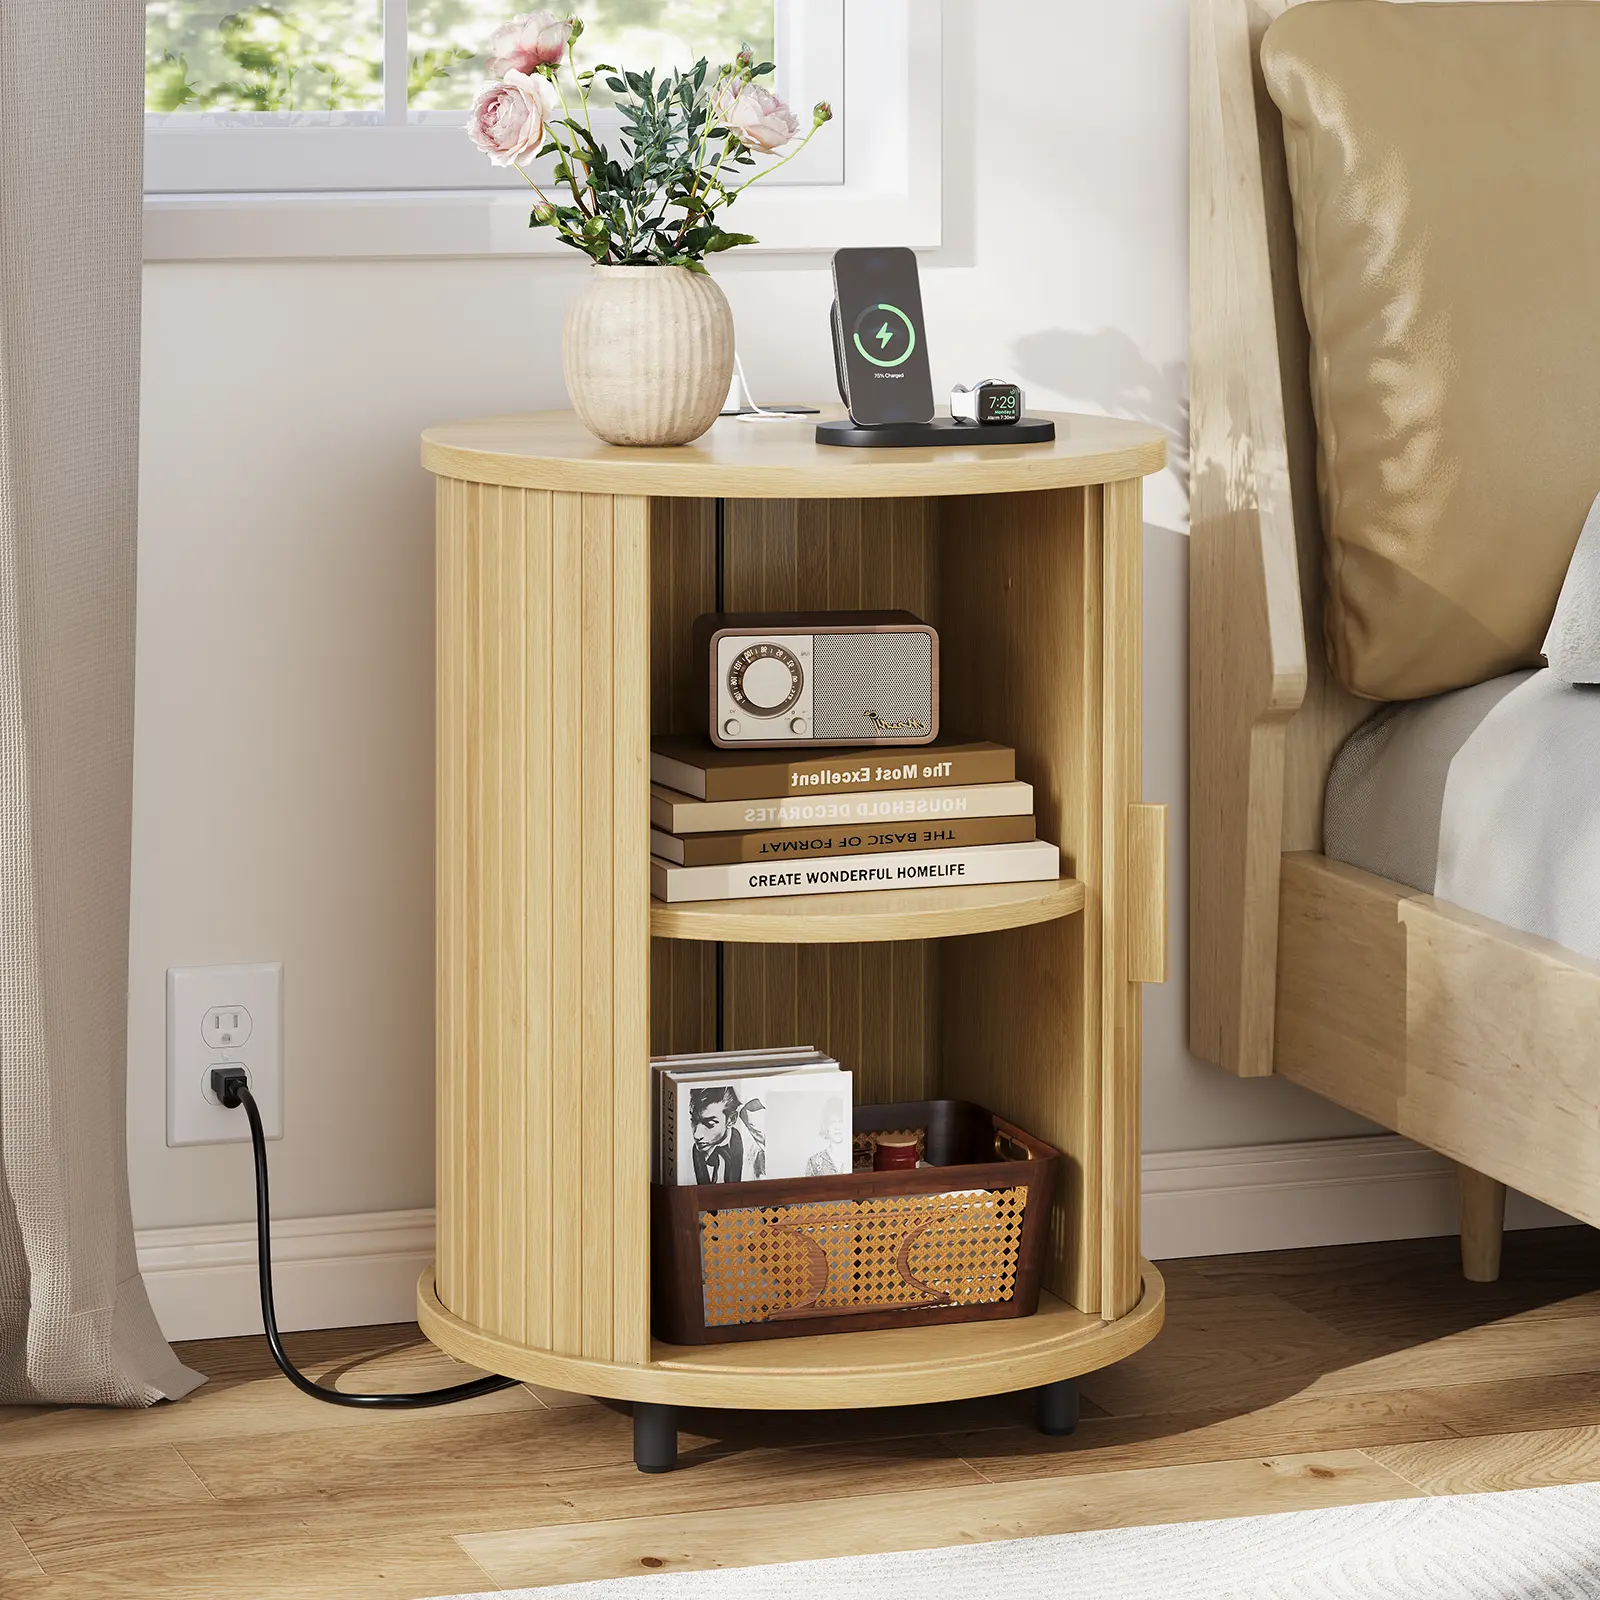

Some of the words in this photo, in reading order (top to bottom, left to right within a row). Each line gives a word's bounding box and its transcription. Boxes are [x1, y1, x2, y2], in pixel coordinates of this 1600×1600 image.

[989, 395, 1016, 409] 7:29
[839, 836, 862, 848] OF
[867, 831, 917, 846] BASIC
[923, 829, 956, 842] THE
[759, 838, 832, 854] FORMAT
[749, 872, 802, 888] CREATE
[806, 867, 893, 885] WONDERFUL
[897, 863, 966, 879] HOMELIFE
